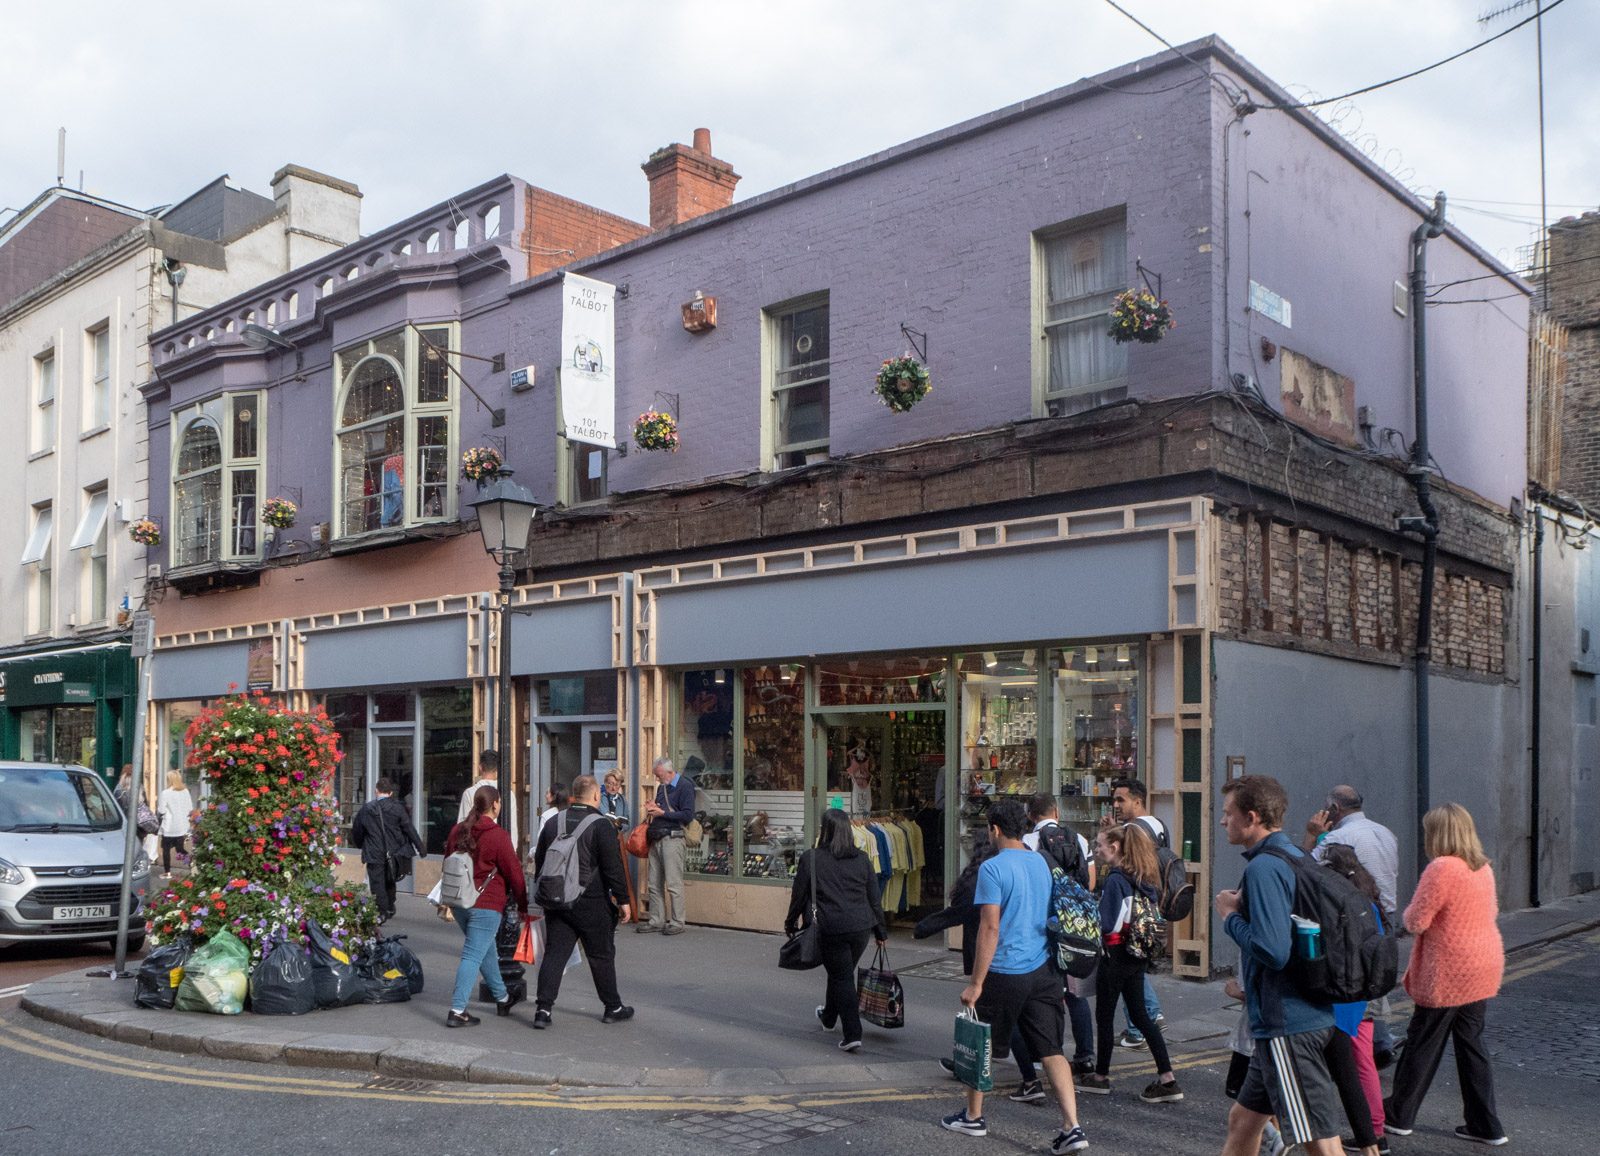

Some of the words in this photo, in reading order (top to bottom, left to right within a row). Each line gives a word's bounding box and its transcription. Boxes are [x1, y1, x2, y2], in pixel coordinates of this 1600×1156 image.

[582, 288, 597, 299] 101
[571, 296, 608, 312] TALBOT
[583, 418, 597, 428] 101
[572, 425, 609, 440] TALBOT
[60, 907, 84, 918] SY13
[86, 906, 105, 917] TZN
